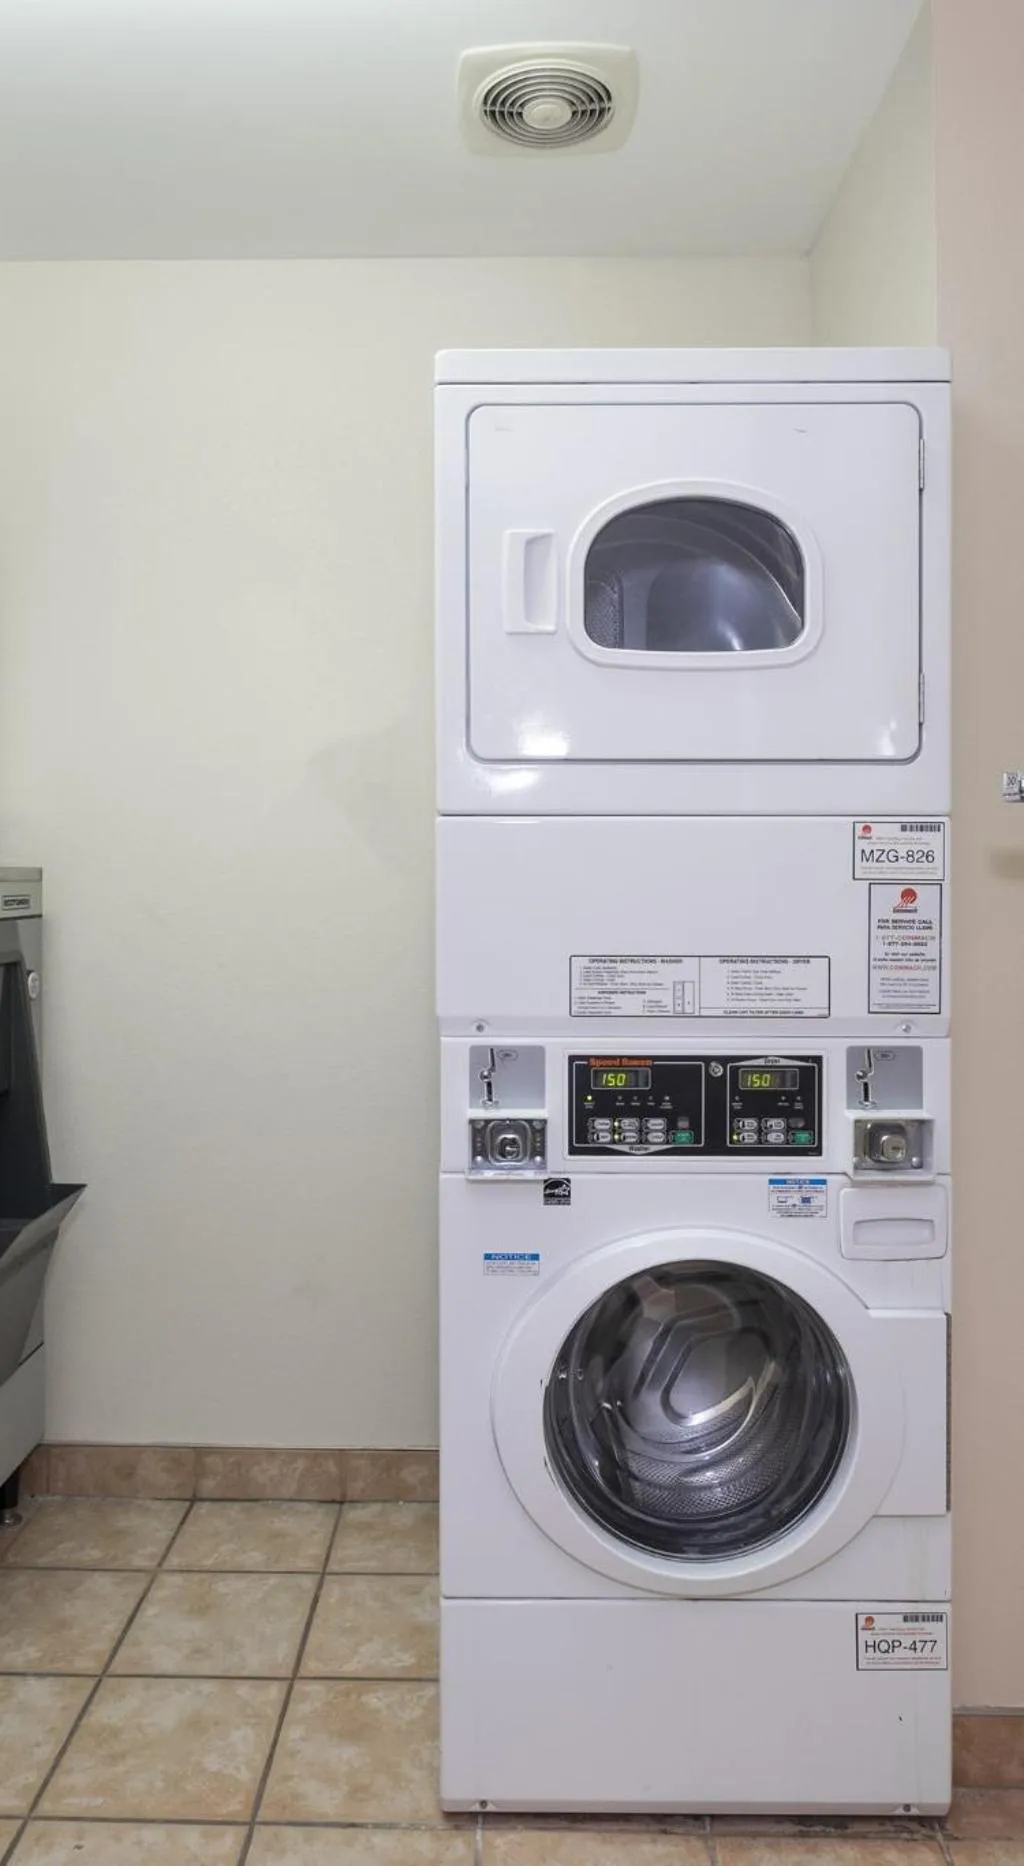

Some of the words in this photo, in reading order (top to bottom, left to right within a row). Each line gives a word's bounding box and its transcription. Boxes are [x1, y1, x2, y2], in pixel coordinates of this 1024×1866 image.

[861, 848, 935, 863] MZG-826
[602, 1073, 626, 1086] 150
[747, 1073, 771, 1087] 150
[864, 1639, 938, 1654] HQP-477
